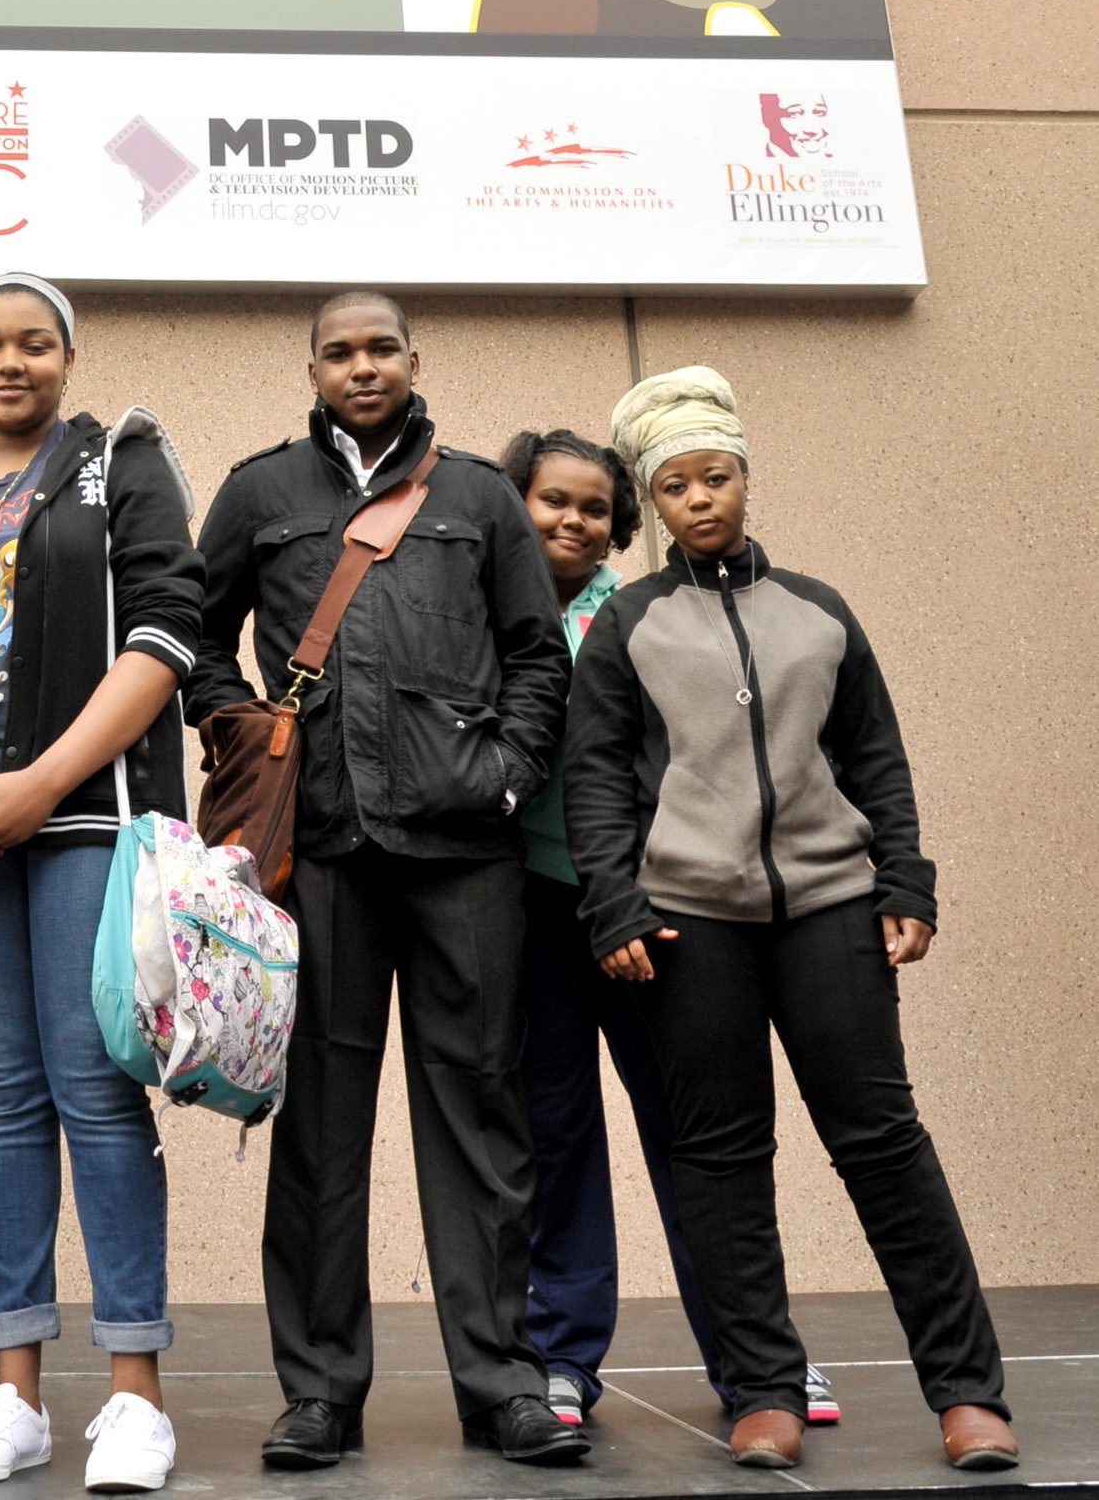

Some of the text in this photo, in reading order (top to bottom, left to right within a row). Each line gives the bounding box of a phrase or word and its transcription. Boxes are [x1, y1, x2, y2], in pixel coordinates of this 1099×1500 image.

[208, 118, 413, 169] MPTD
[209, 173, 419, 186] DC OFFICE OF MOTION PICTURE
[725, 163, 816, 193] Duke
[209, 184, 420, 196] & TELEVISION DEVELOPMENT
[484, 185, 658, 197] DC COMMISSION ON
[211, 196, 341, 227] film.dc.gov
[466, 197, 675, 209] THE ARTS & HUMANITIES
[728, 193, 885, 233] Ellington
